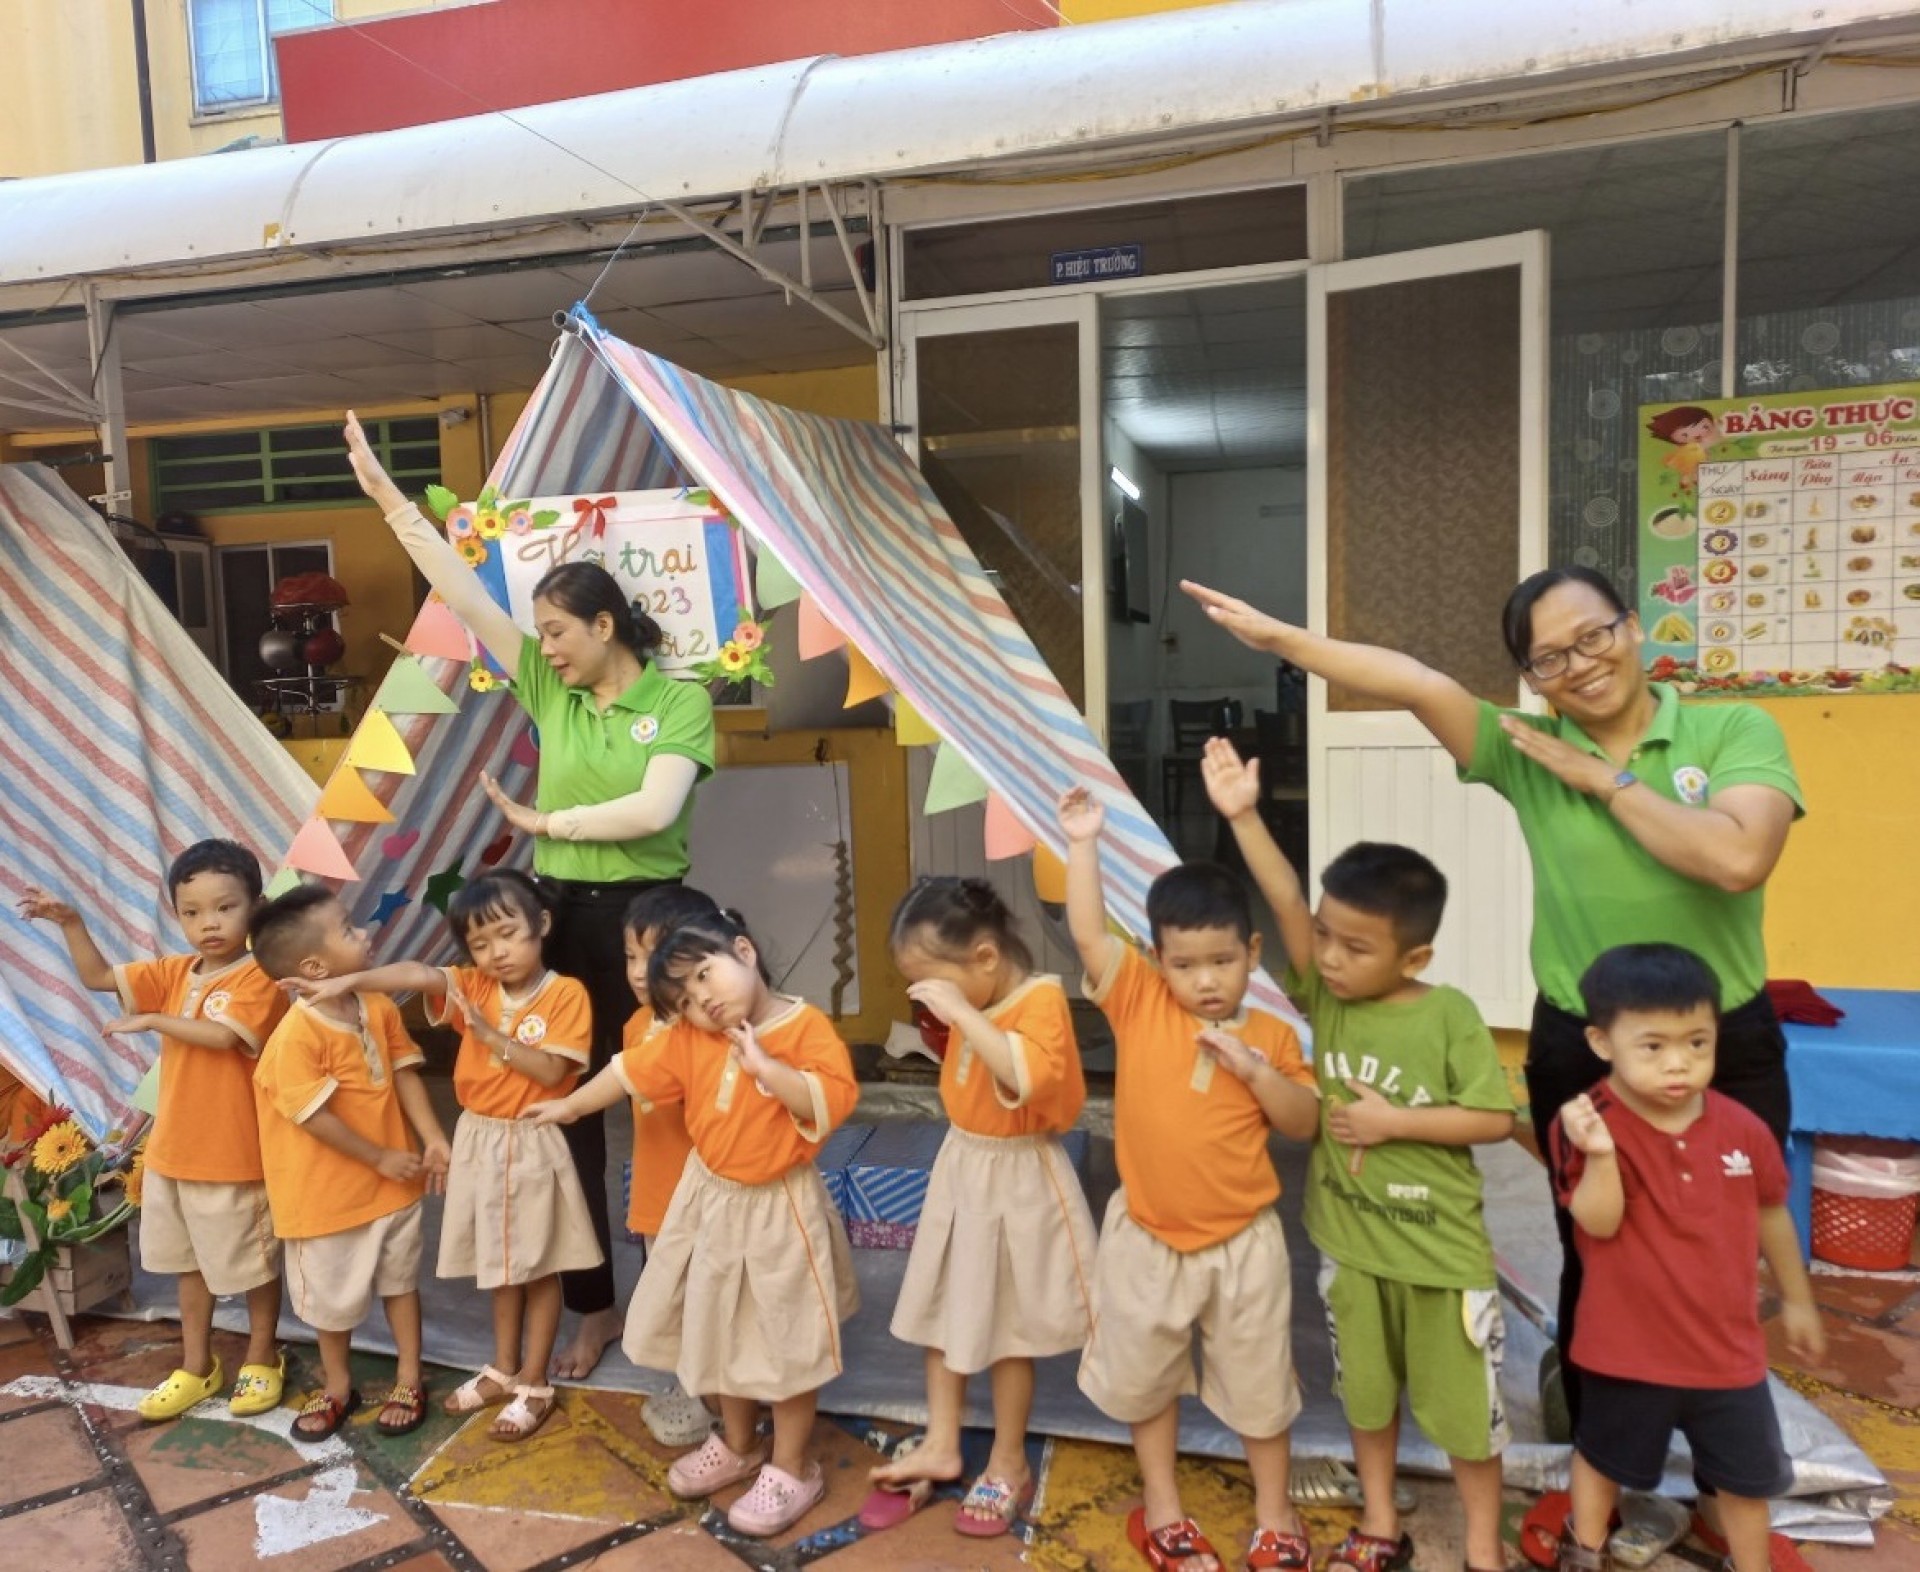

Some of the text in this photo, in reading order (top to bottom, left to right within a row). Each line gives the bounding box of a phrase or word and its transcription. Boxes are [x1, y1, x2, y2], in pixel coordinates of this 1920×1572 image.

[1725, 398, 1914, 434] BẢNG THỰC
[1810, 434, 1838, 452] 19
[1864, 430, 1893, 447] 06
[632, 586, 693, 615] 023
